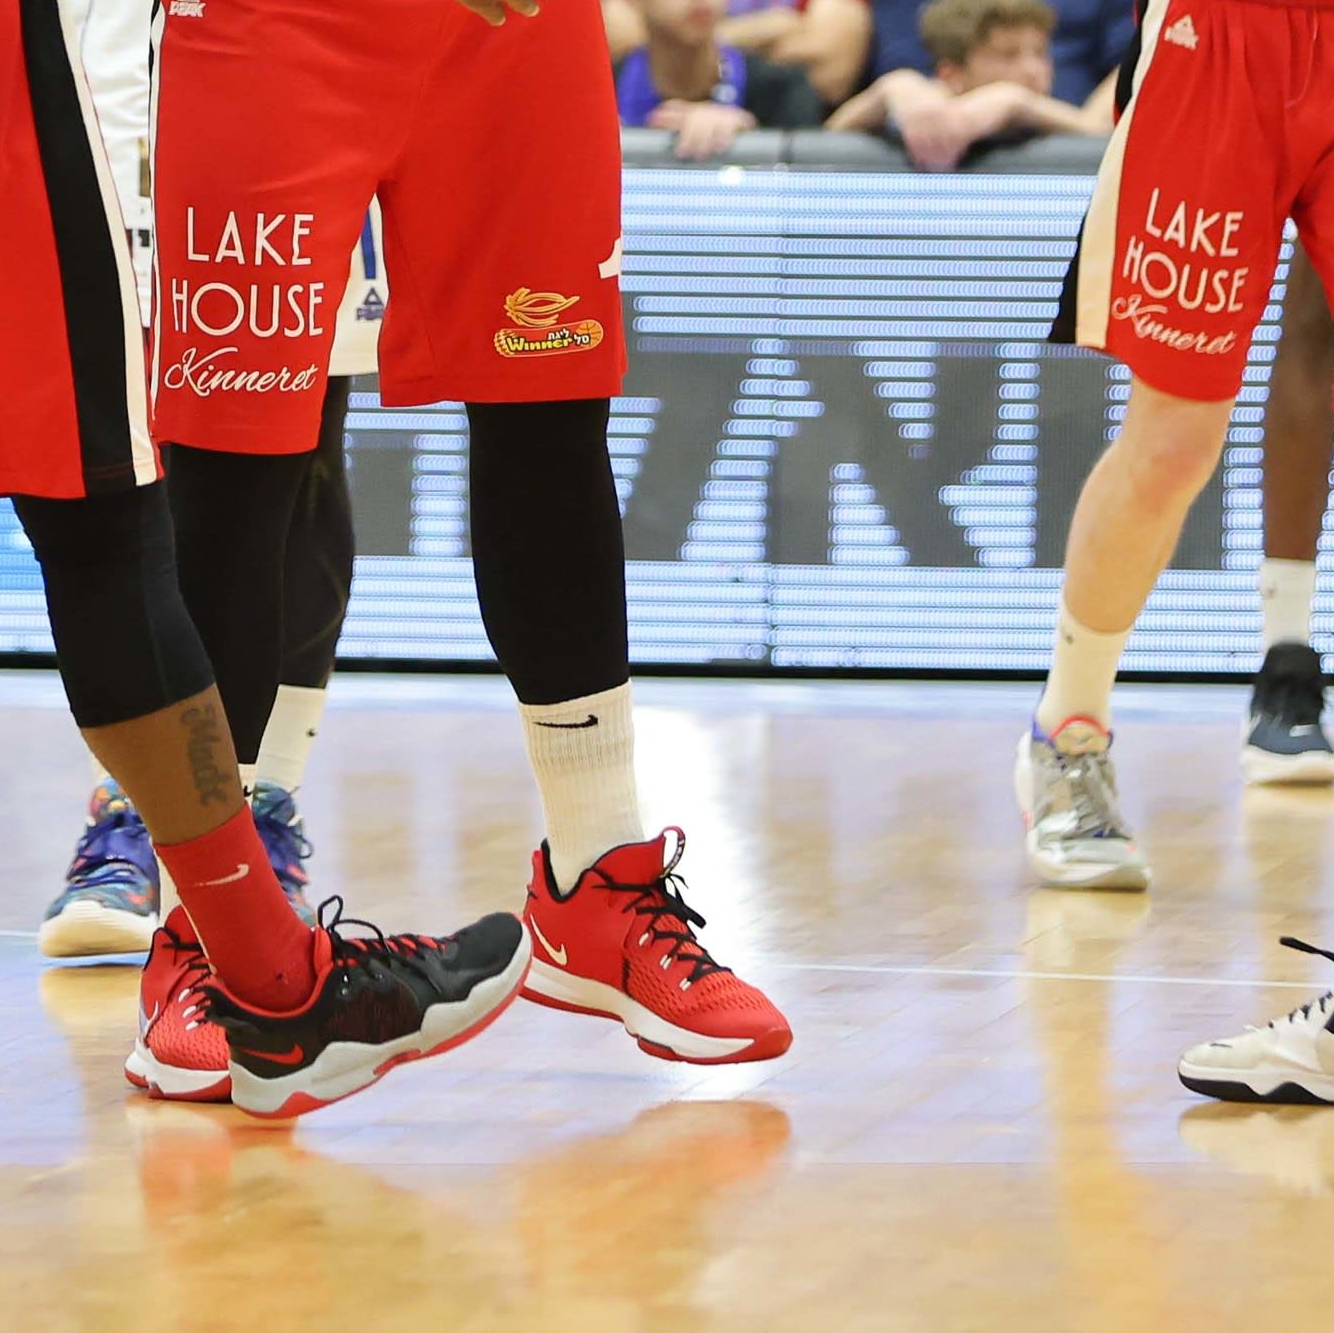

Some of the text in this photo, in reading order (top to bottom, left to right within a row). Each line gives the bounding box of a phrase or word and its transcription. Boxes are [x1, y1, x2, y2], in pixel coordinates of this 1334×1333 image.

[168, 0, 207, 18] PEAK
[186, 205, 315, 267] LAKE
[1145, 187, 1245, 258] LAKE
[1121, 235, 1249, 314] HOUSE
[171, 277, 325, 339] HOUSE
[547, 328, 570, 341] ליגת
[506, 334, 590, 352] Winner סל
[163, 346, 319, 398] Kinneret
